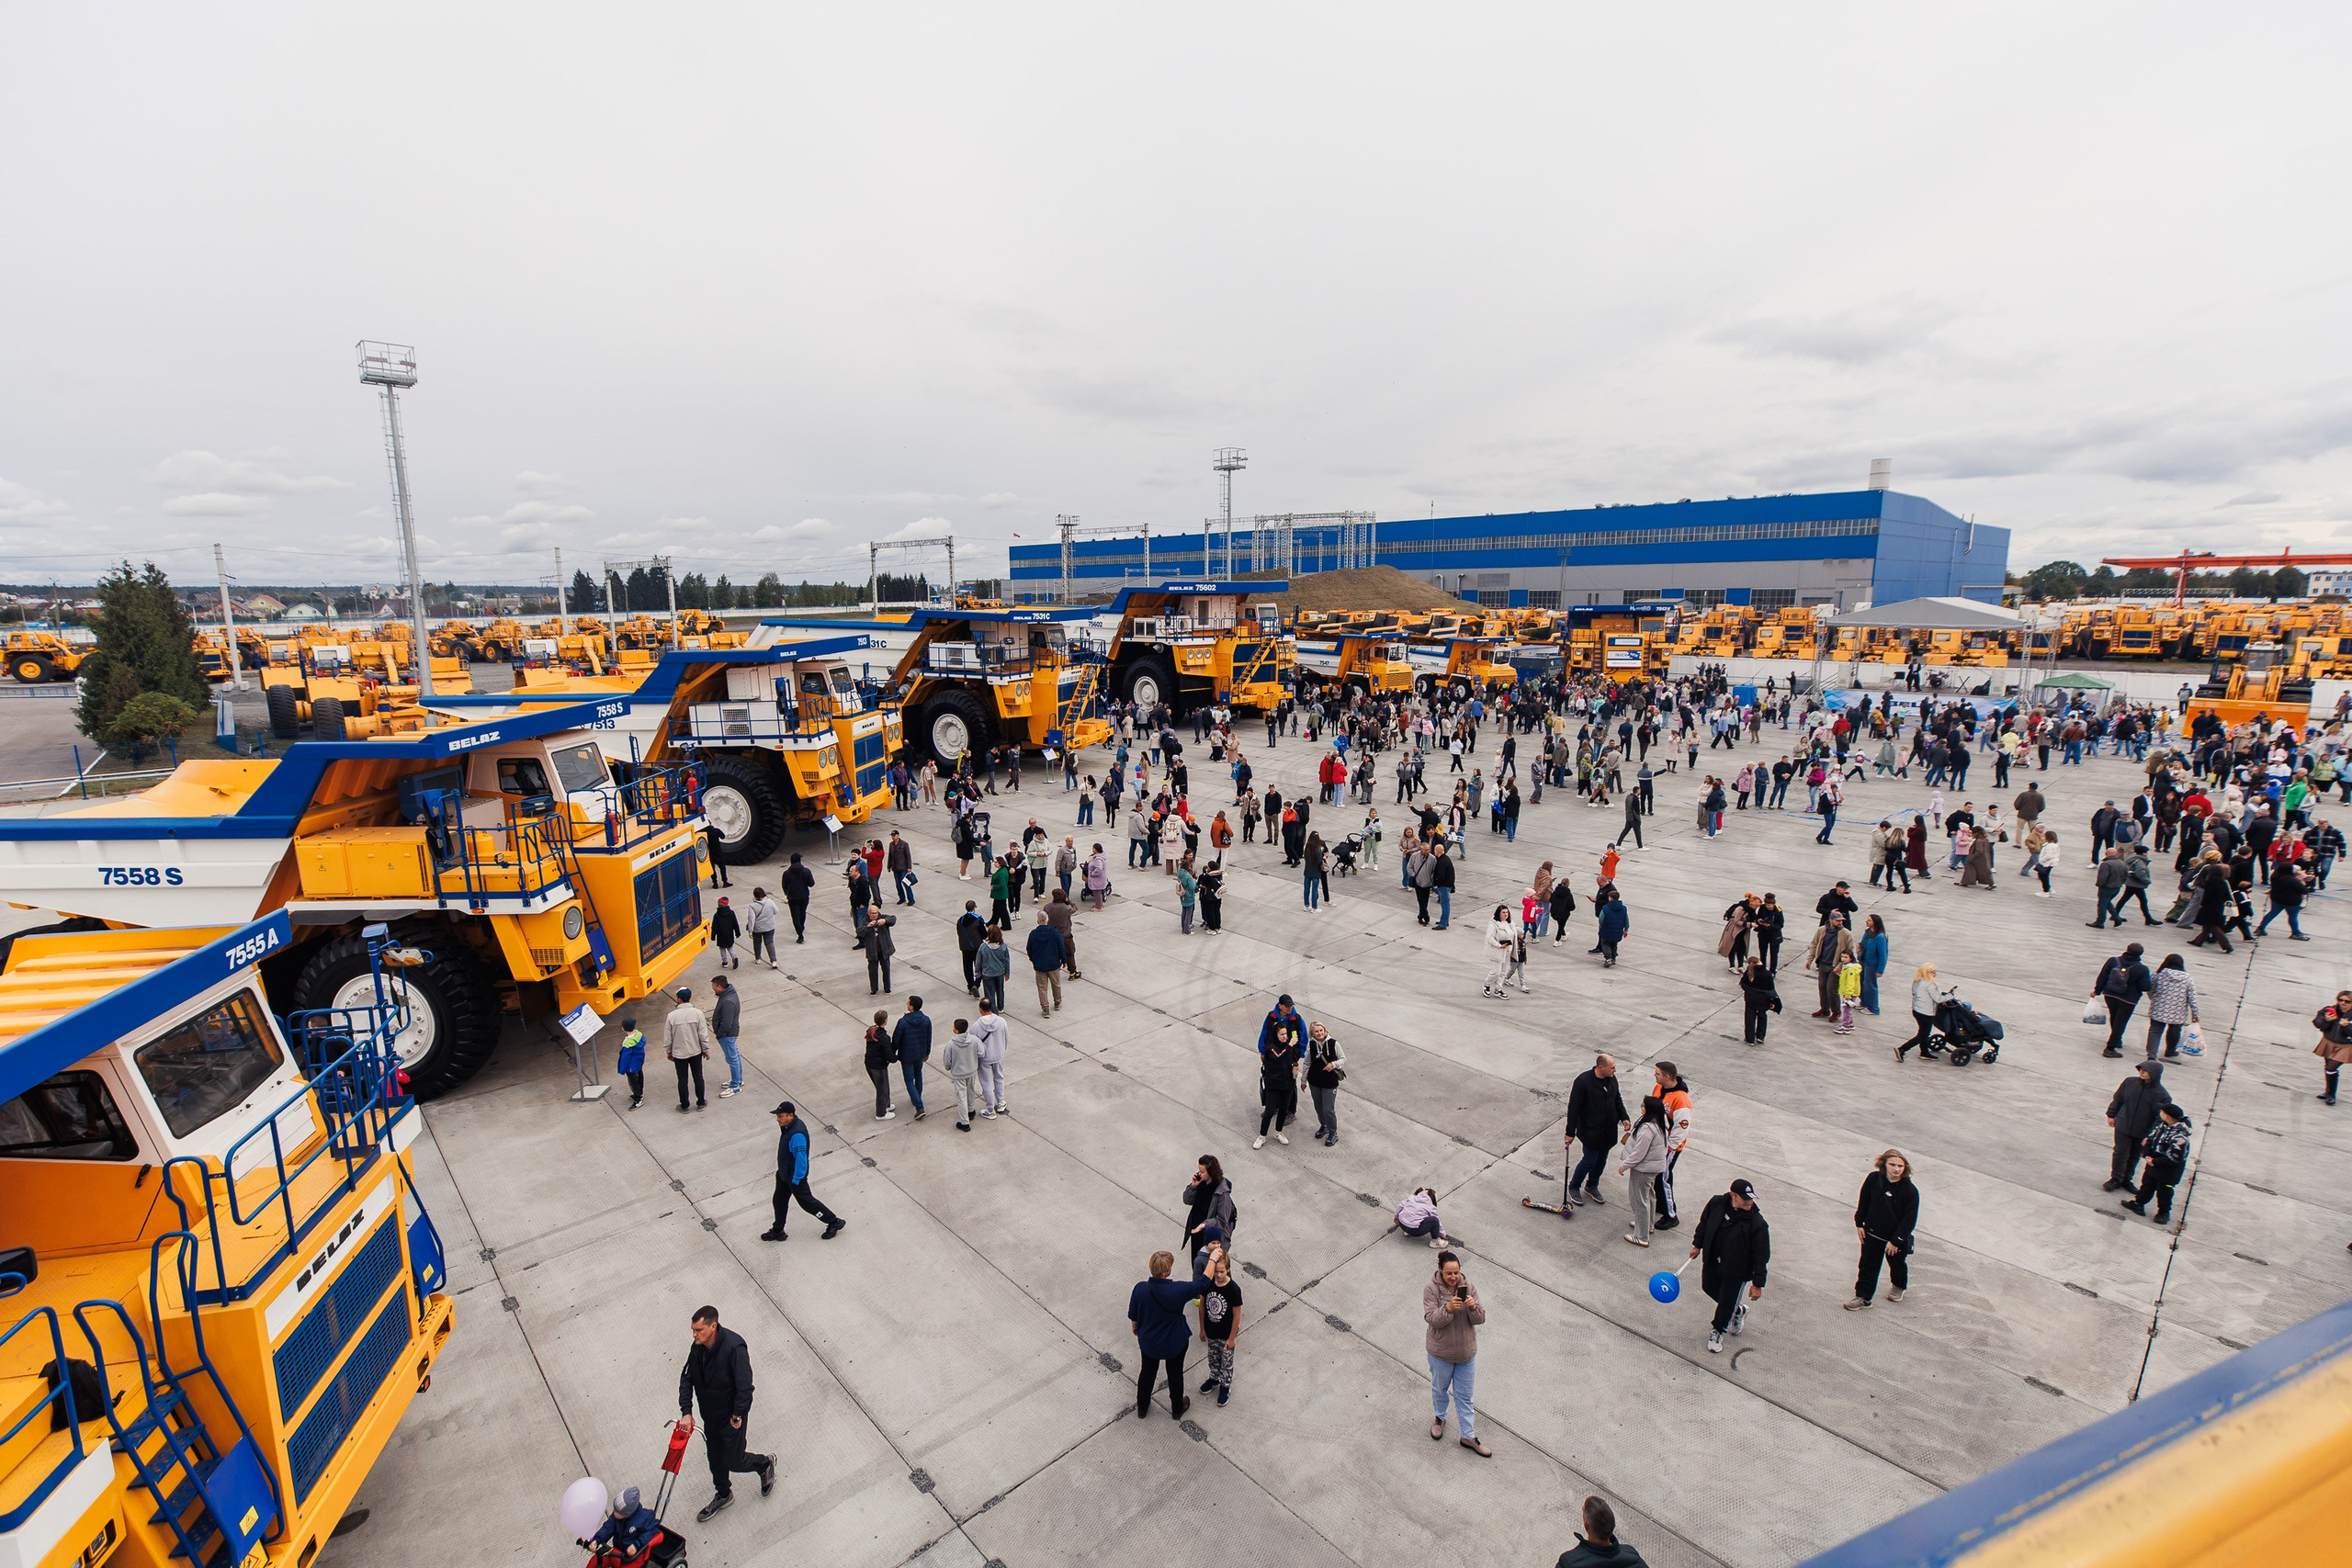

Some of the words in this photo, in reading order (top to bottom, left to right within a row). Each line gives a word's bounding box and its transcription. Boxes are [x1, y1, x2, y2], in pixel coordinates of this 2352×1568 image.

[596, 704, 616, 718] 7558
[616, 701, 624, 714] S
[448, 730, 502, 751] BELAZ
[649, 840, 677, 860] BELAZ
[97, 867, 161, 886] 7558
[164, 867, 184, 886] S
[225, 932, 266, 970] 7555
[267, 927, 280, 950] A
[296, 1208, 365, 1293] BELAZ
